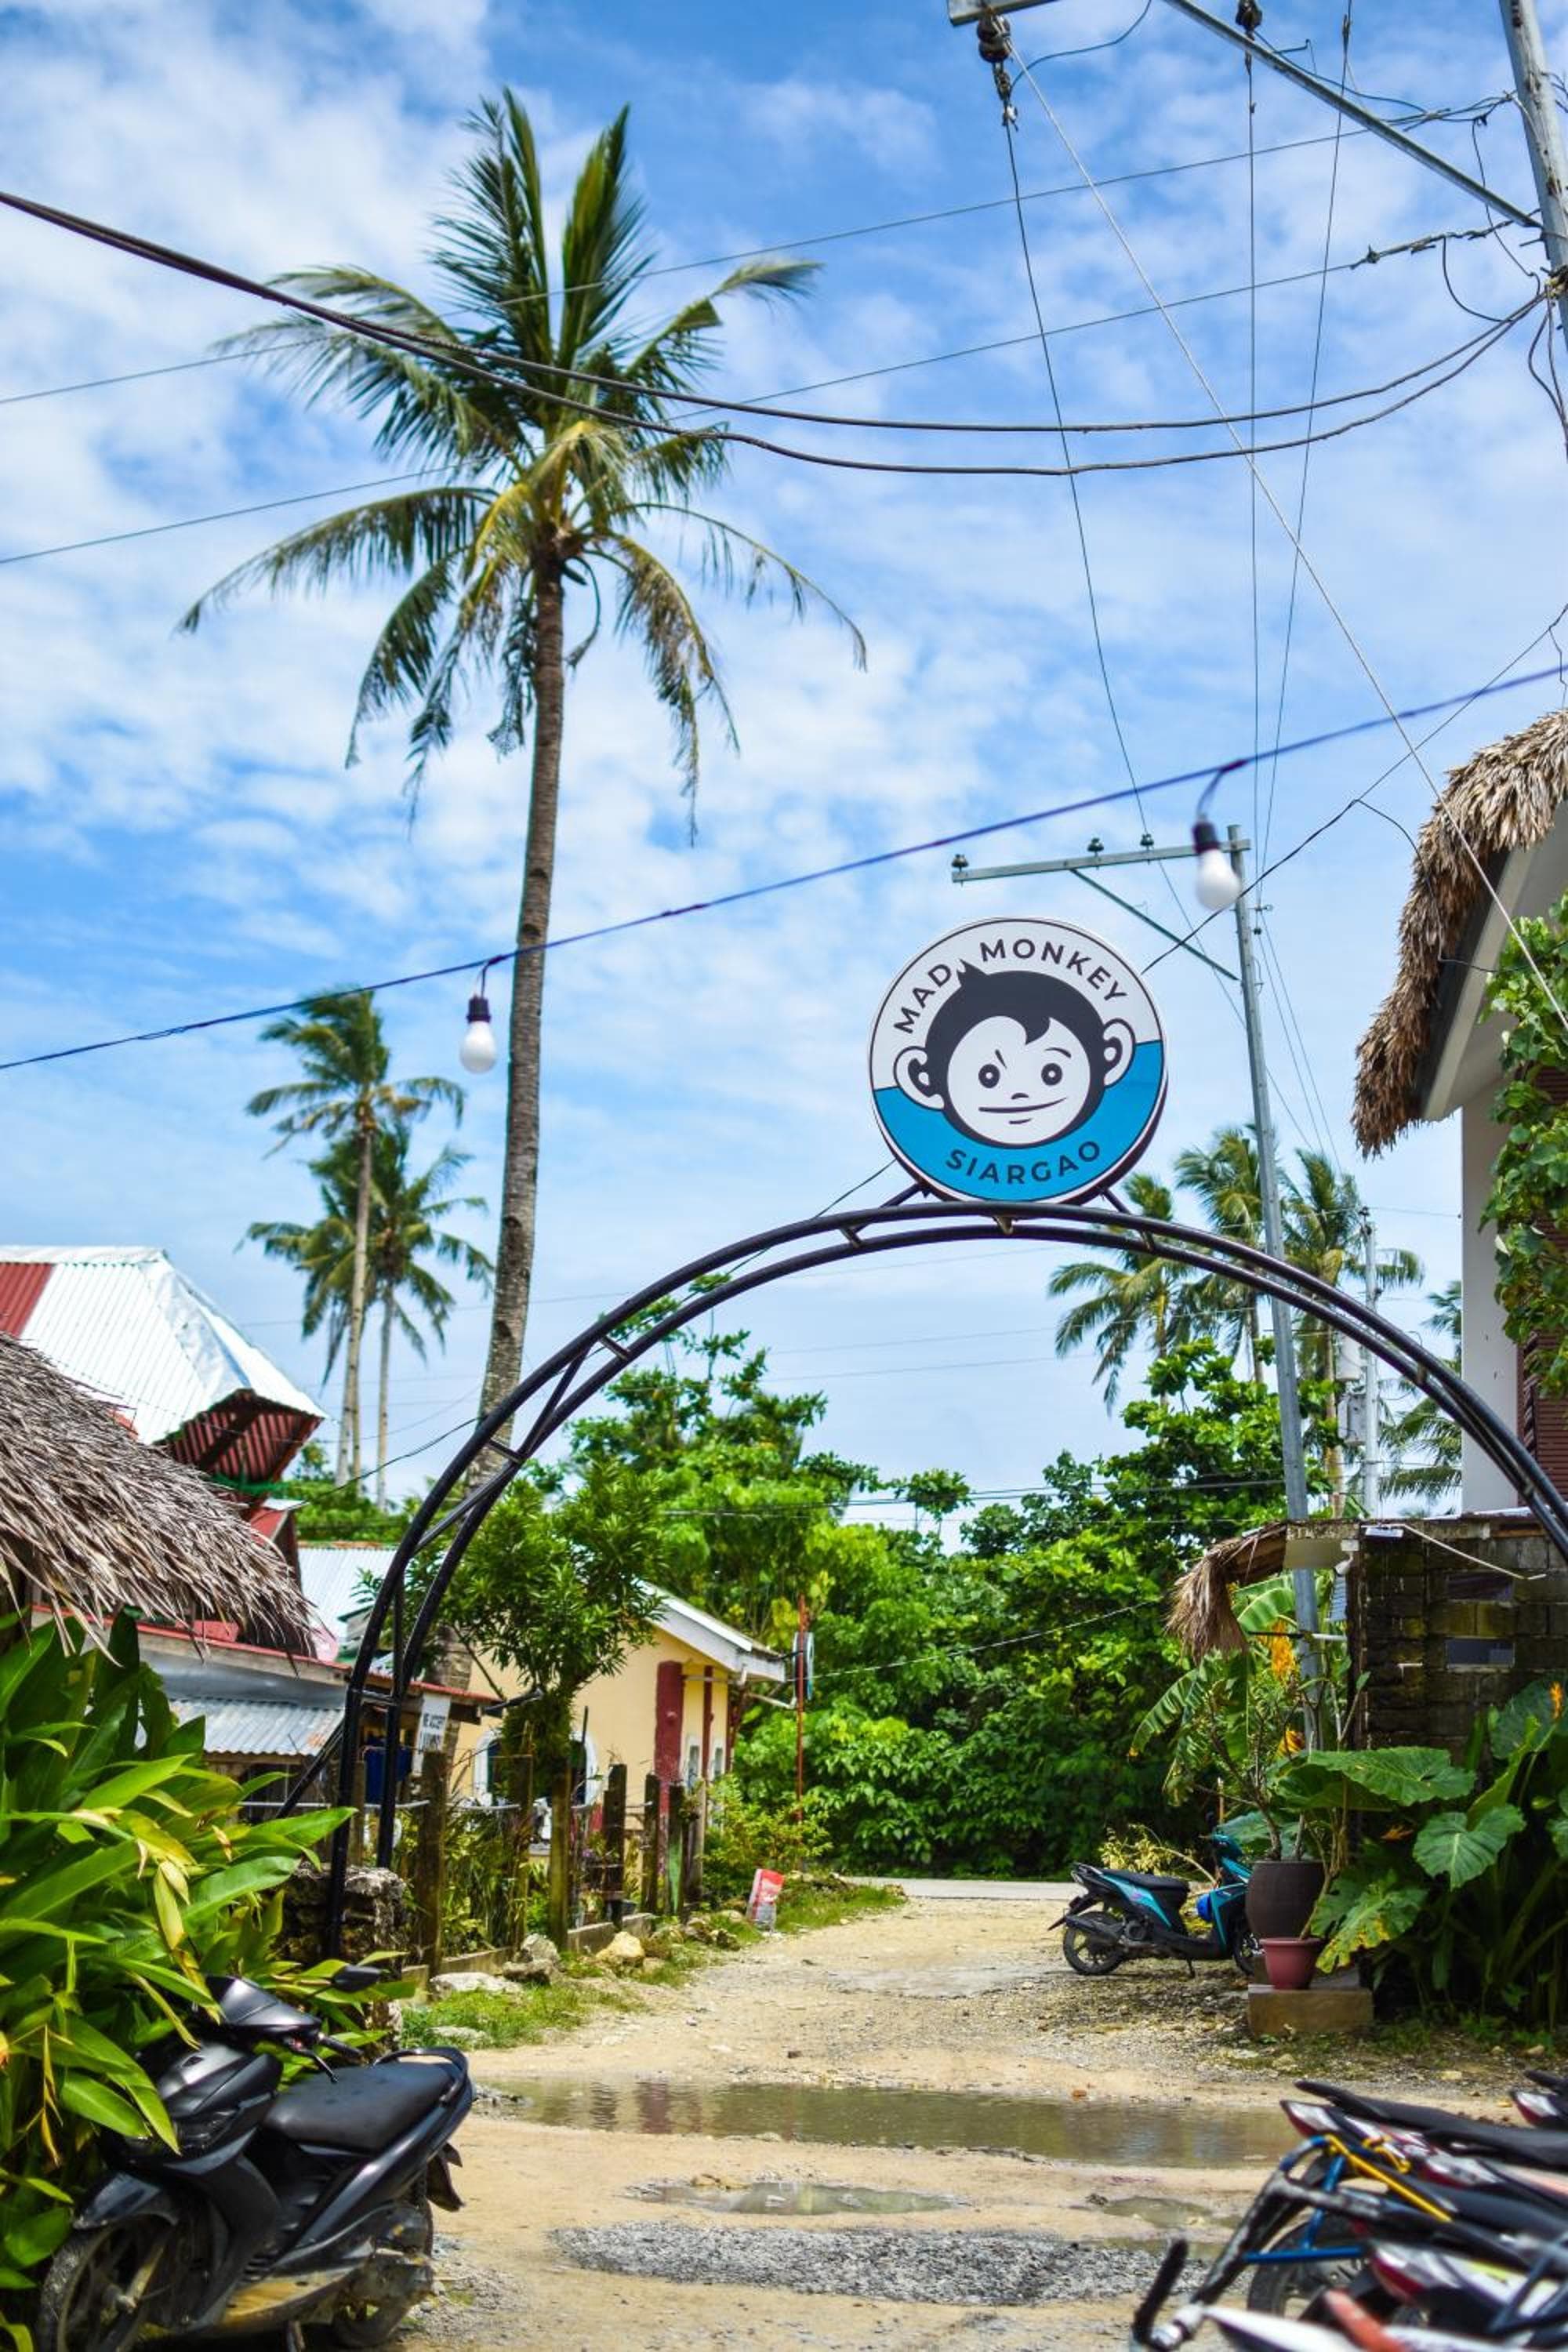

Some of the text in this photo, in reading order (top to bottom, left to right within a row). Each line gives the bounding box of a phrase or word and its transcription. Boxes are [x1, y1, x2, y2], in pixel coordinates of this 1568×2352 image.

[894, 938, 1127, 1033] MAD MONKEY
[946, 1141, 1100, 1185] SIARGAO
